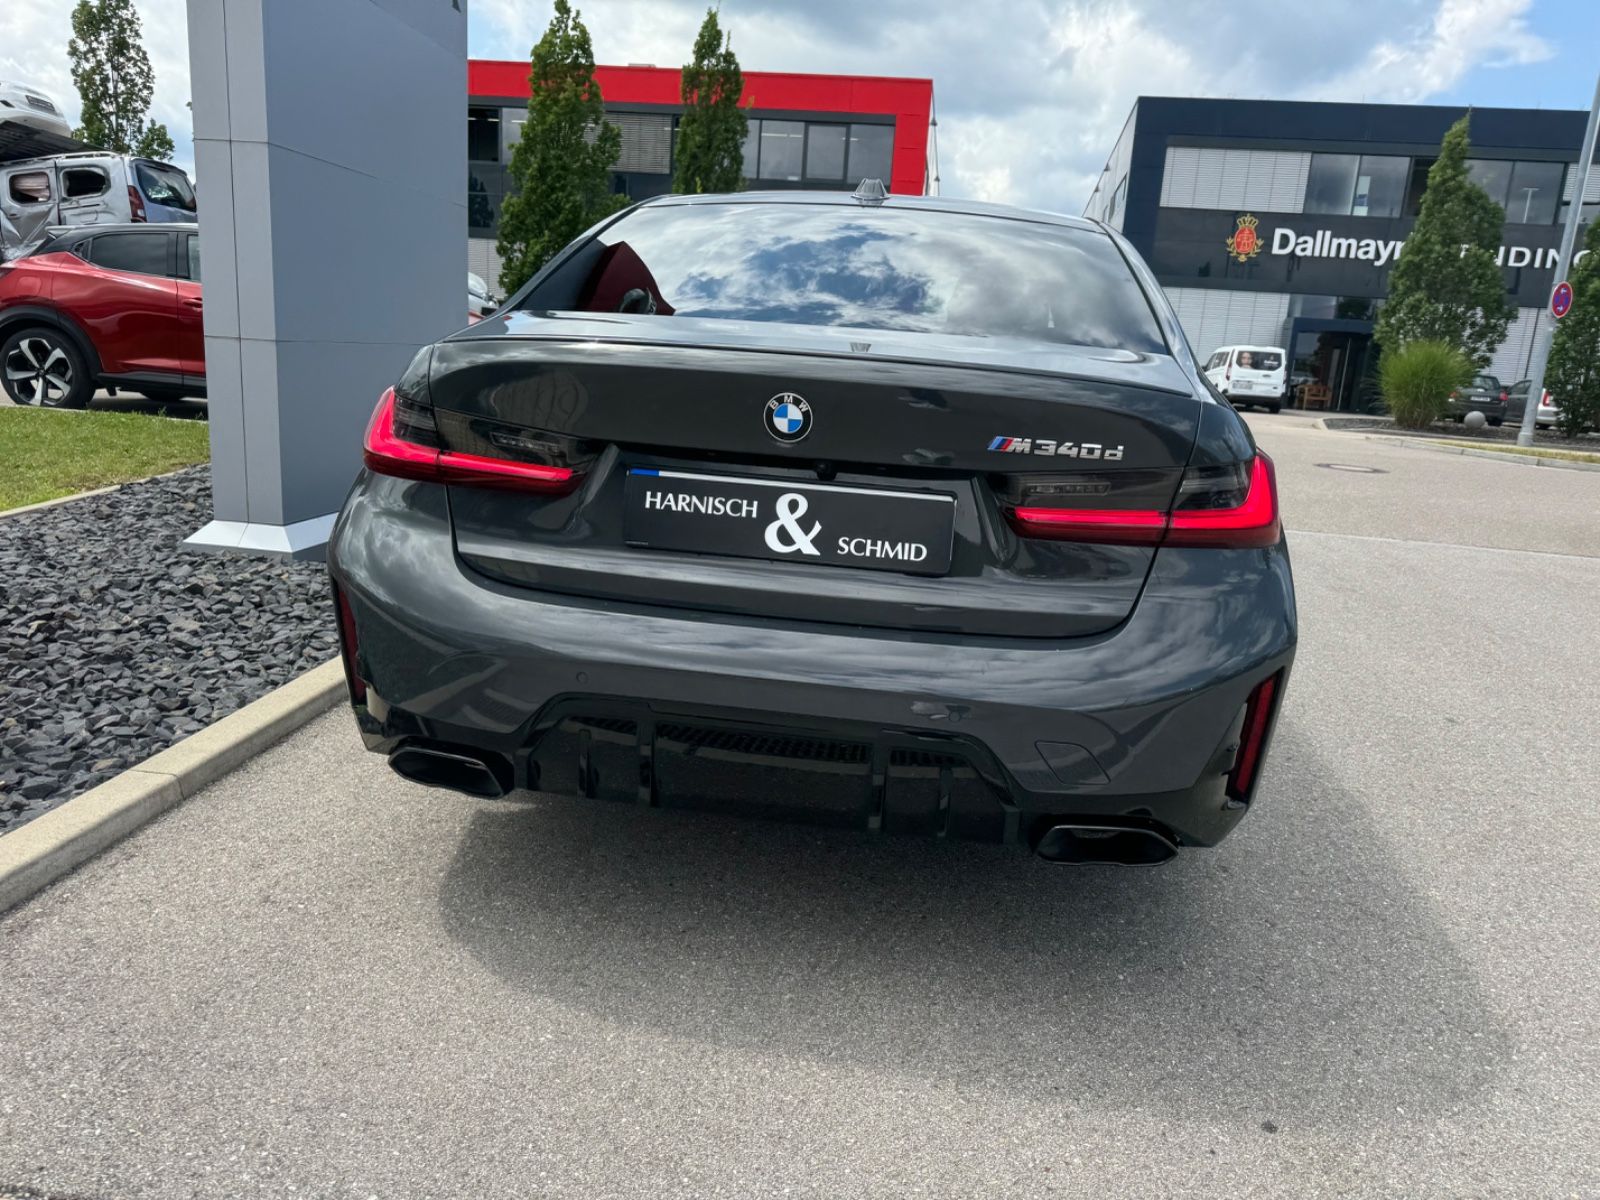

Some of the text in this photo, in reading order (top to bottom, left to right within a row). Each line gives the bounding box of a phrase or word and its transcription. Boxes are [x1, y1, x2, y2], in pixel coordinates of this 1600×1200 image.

[769, 394, 809, 412] BMW
[1003, 436, 1125, 461] M340d
[644, 490, 928, 562] HARNISCH & SCHMID
